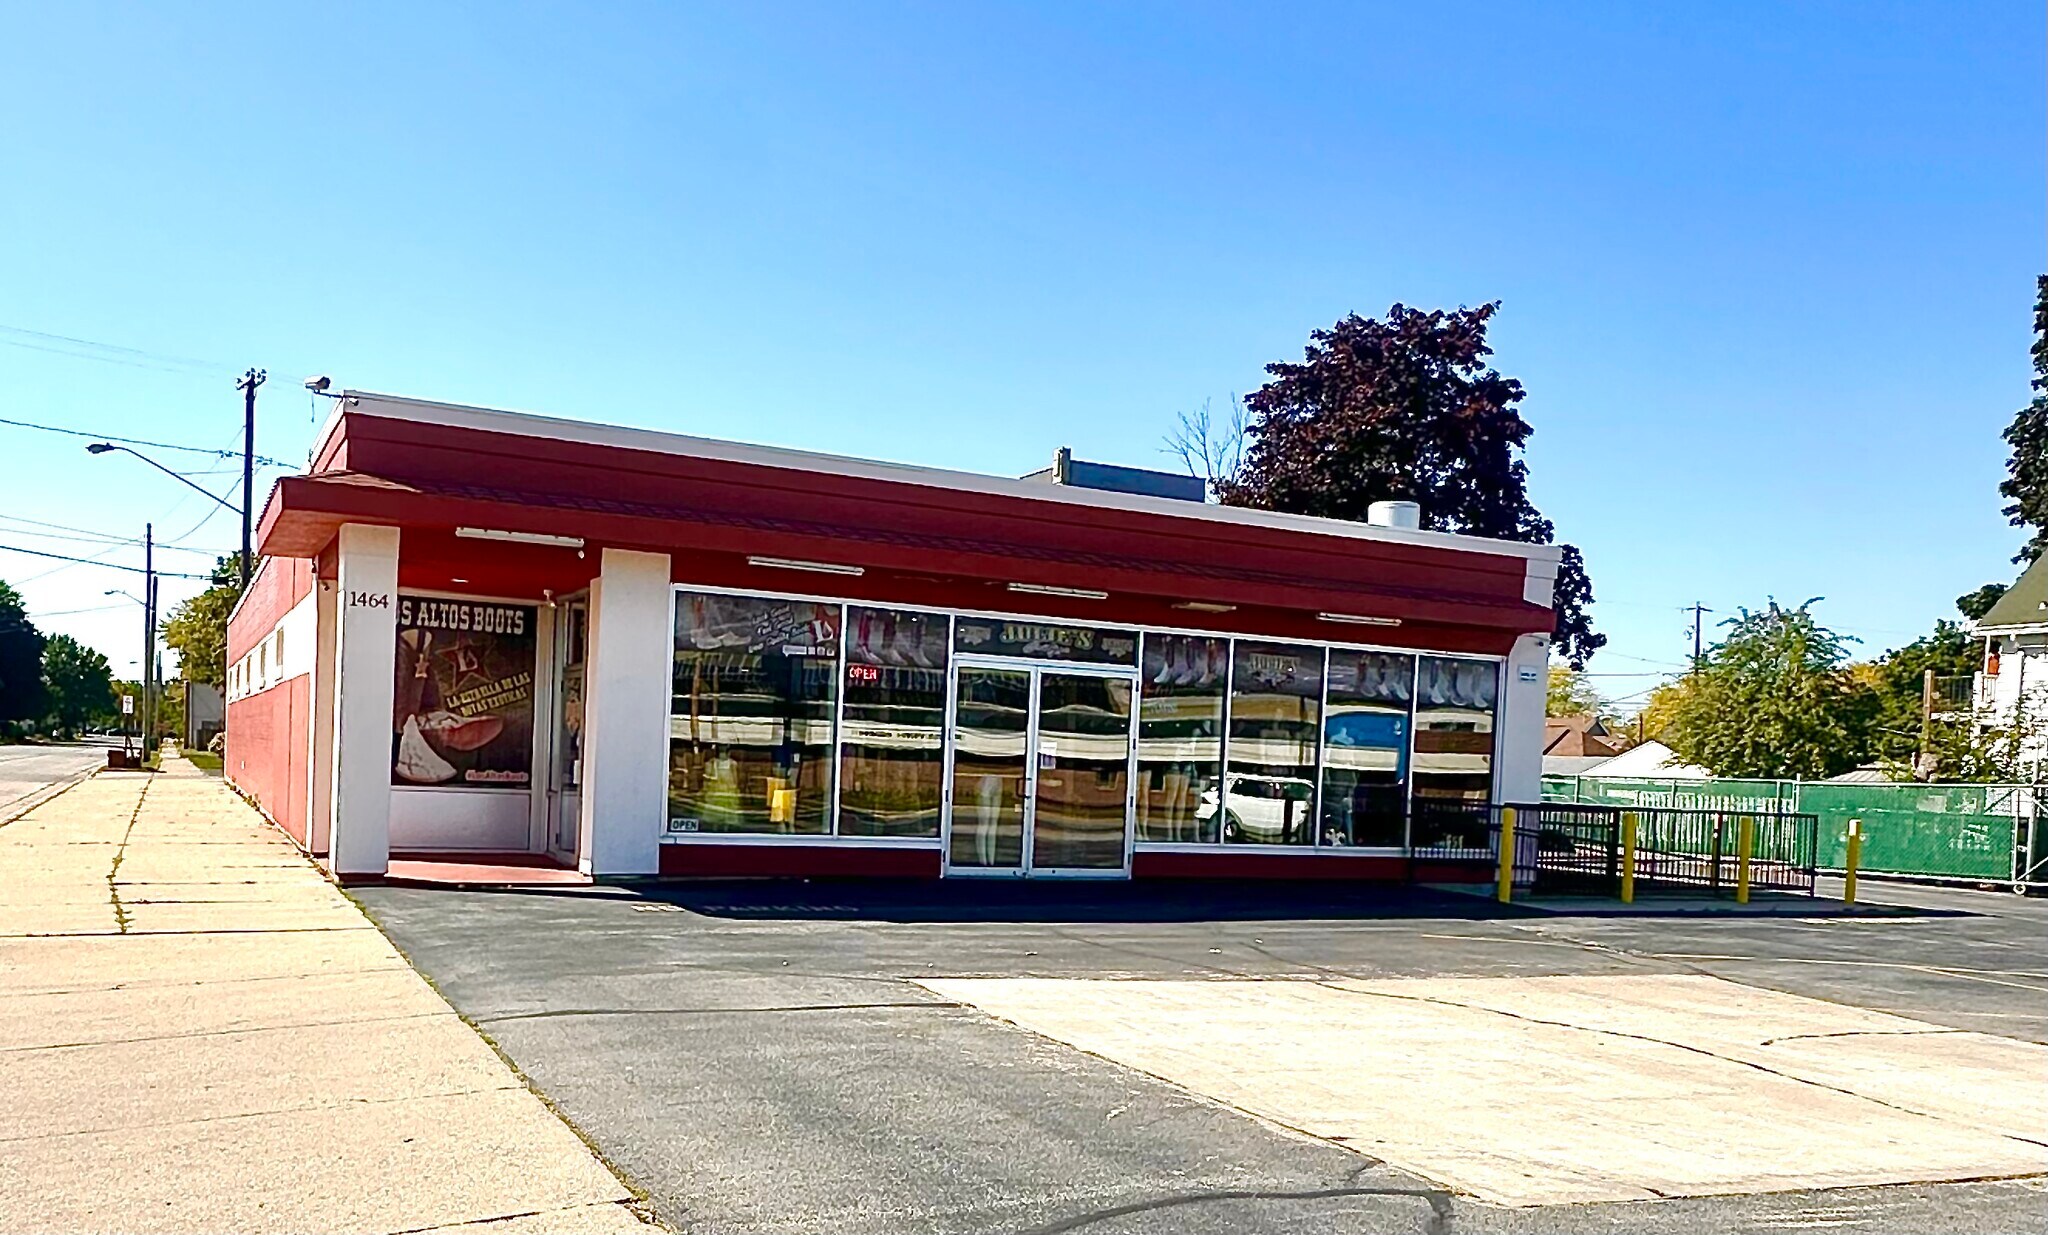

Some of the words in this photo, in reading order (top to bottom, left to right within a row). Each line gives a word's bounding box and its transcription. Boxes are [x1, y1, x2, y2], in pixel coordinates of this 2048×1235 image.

[350, 591, 389, 609] 1464
[417, 602, 470, 630] ALTOS
[473, 607, 524, 635] BOOTS
[849, 666, 877, 680] OPEN
[672, 820, 696, 830] OPEN
